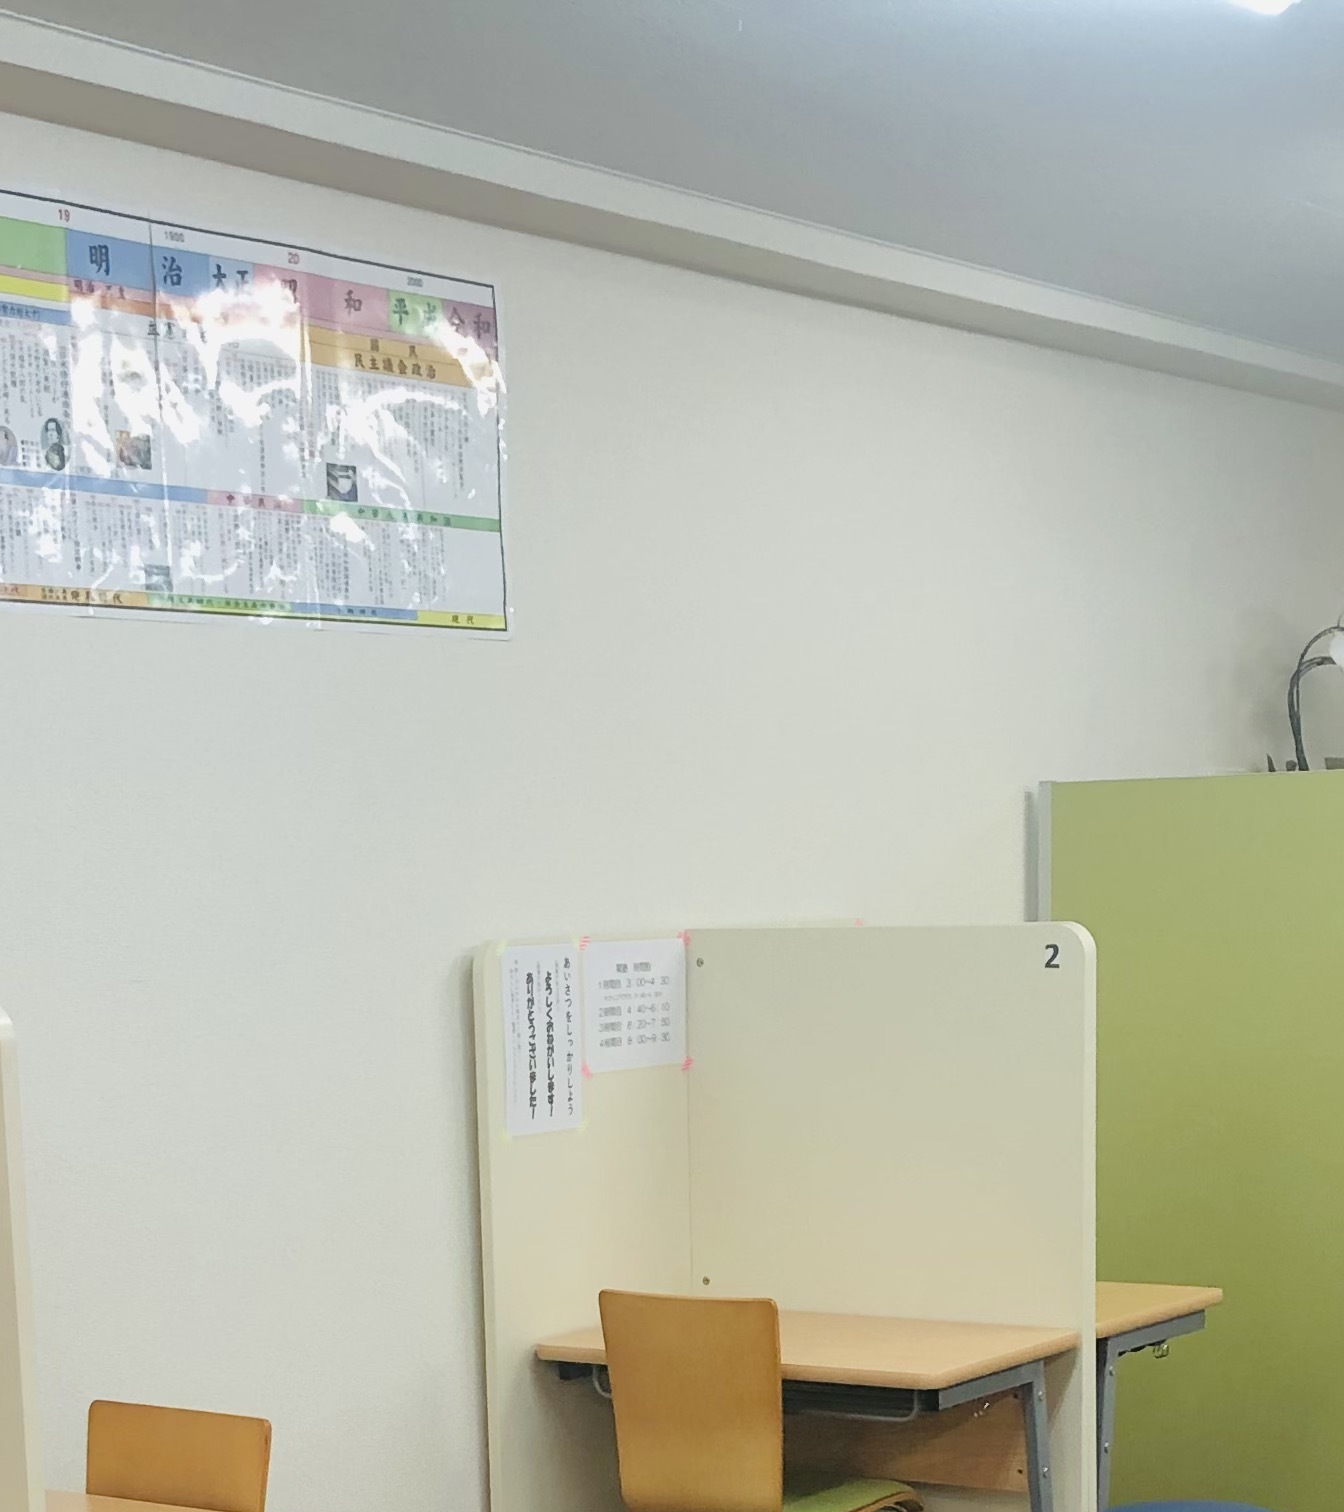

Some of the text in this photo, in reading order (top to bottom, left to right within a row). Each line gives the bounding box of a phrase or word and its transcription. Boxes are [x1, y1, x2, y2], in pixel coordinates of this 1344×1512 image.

[57, 208, 72, 223] 19
[286, 250, 301, 266] 20
[1045, 944, 1060, 969] 2
